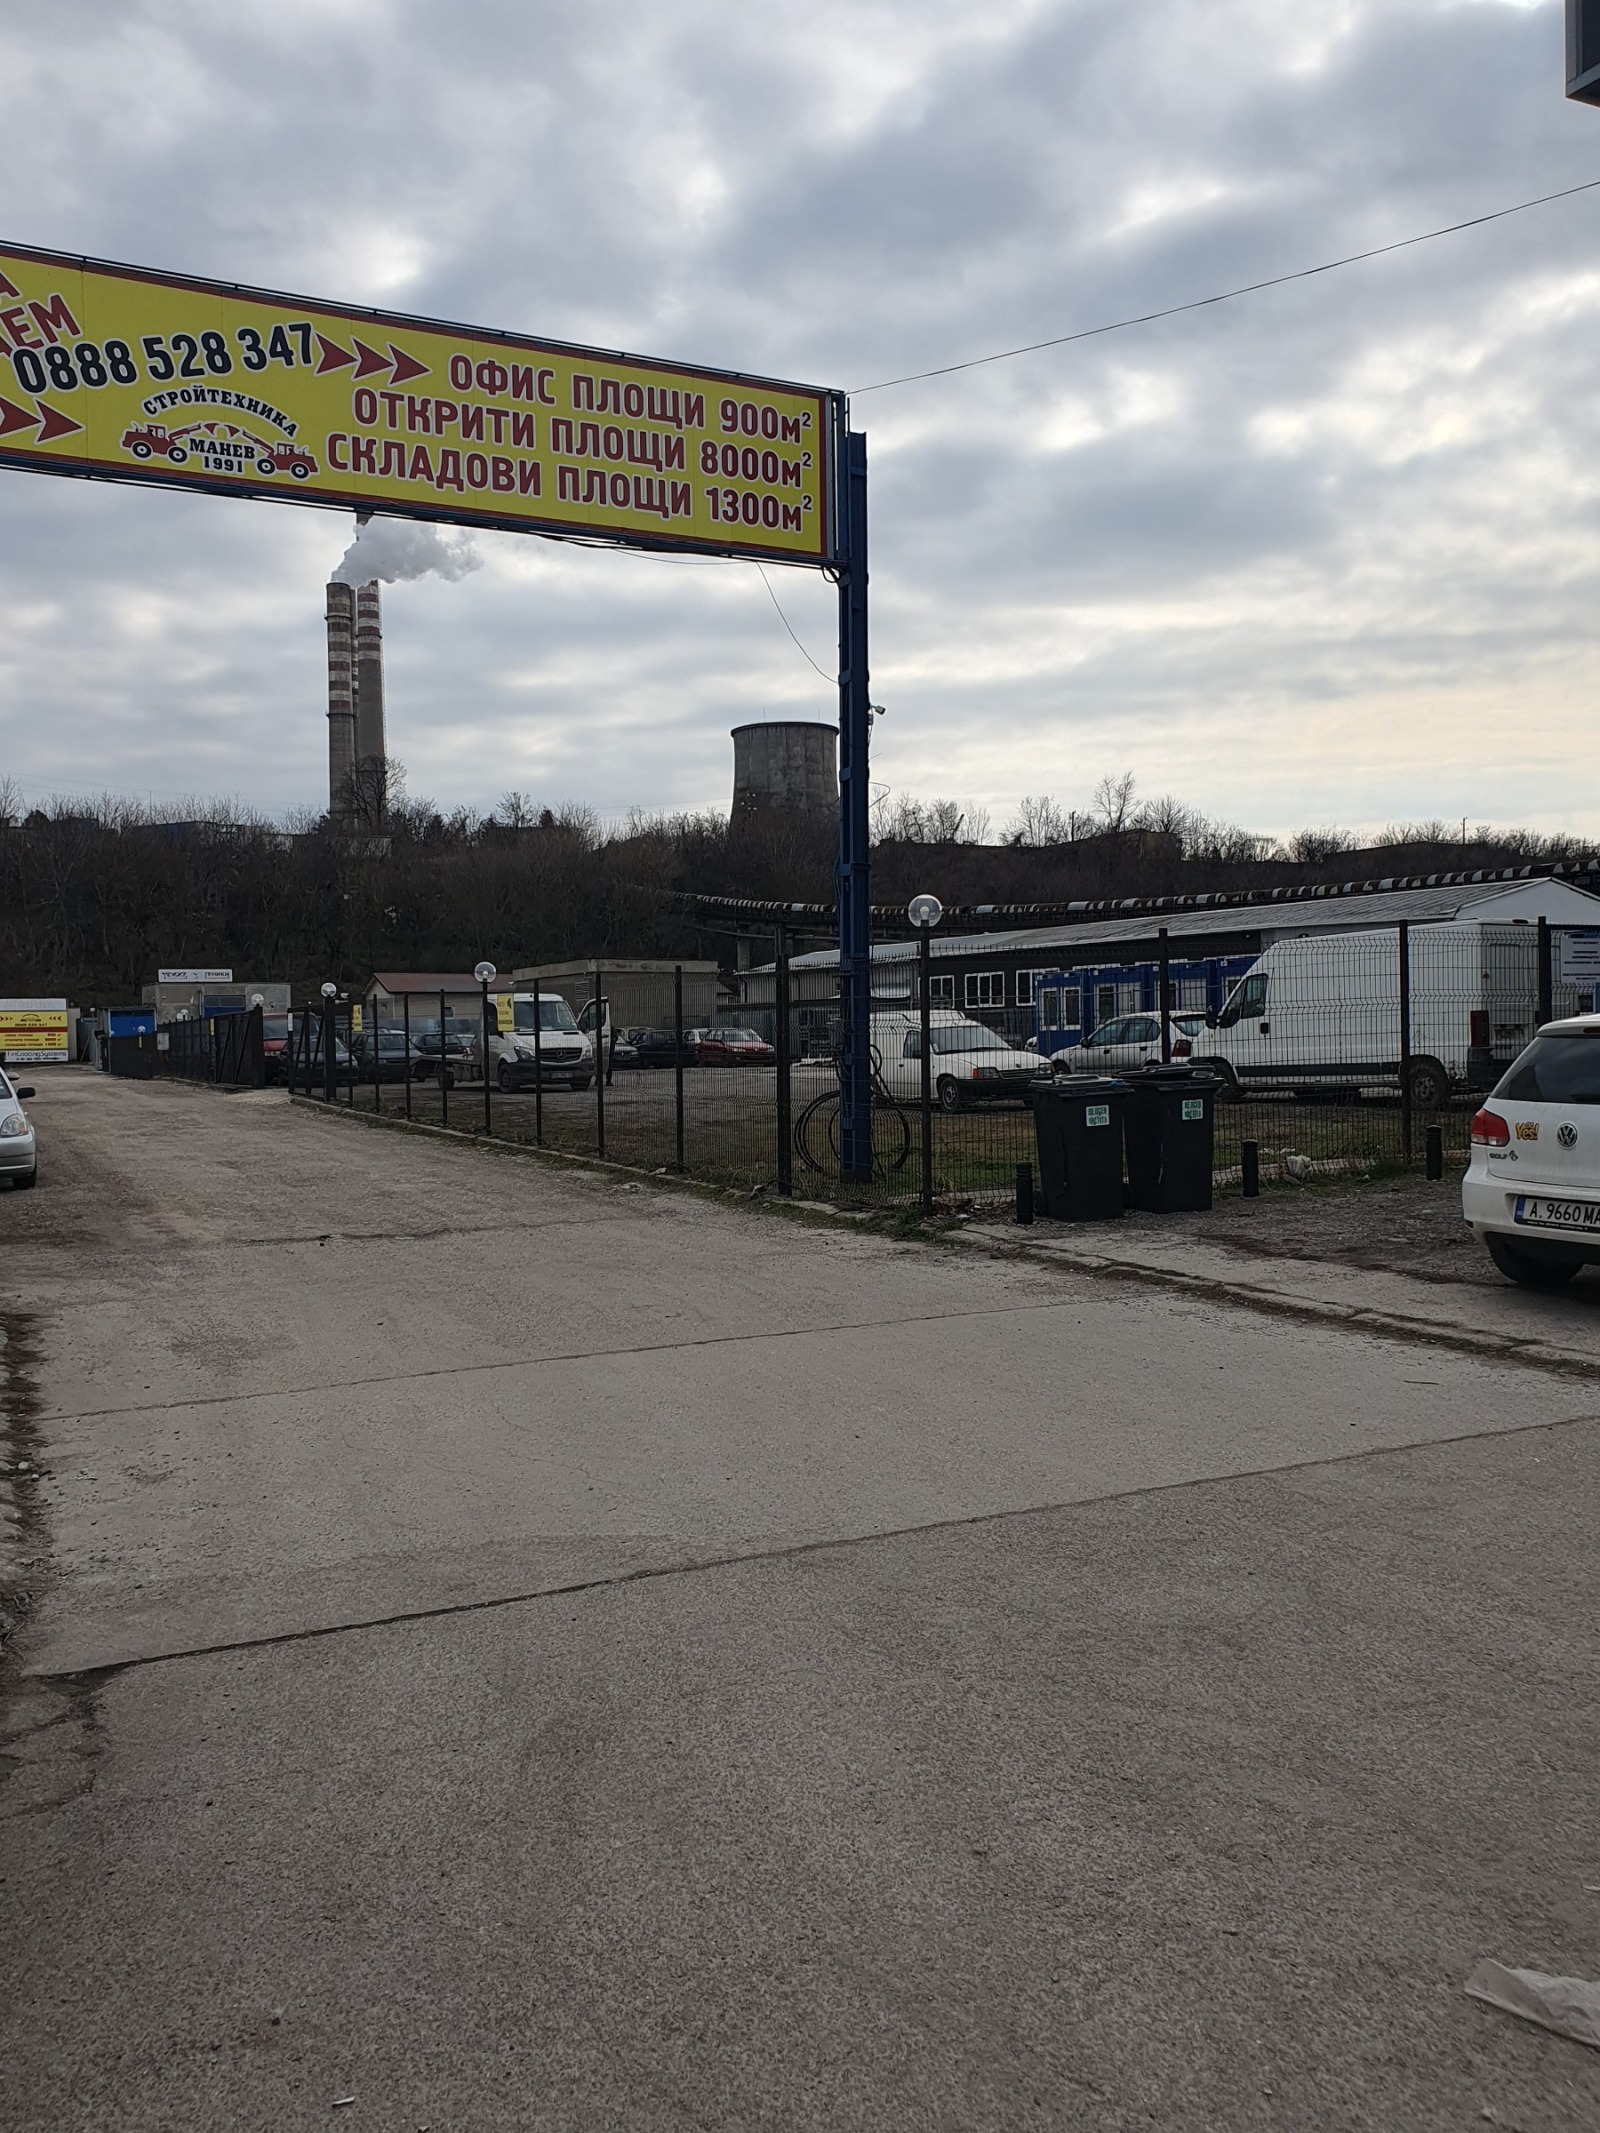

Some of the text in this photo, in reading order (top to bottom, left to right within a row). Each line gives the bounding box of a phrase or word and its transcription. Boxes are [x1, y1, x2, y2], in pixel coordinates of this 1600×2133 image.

[13, 323, 311, 393] 0888 528 347
[143, 385, 298, 437] СТРОЙТЕХНИКА
[451, 355, 554, 404] ОФИС
[573, 375, 704, 429] ПЛОЩИ
[189, 438, 255, 459] МАНЕВ
[355, 389, 534, 448] ОТКРИТИ
[553, 419, 685, 472] ПЛОЩИ
[204, 456, 243, 473] 1991
[328, 434, 541, 496] СКЛАДОВИ
[559, 466, 691, 519] ПЛОЩИ
[1515, 1122, 1540, 1140] Yes!
[1546, 1203, 1581, 1222] 9660
